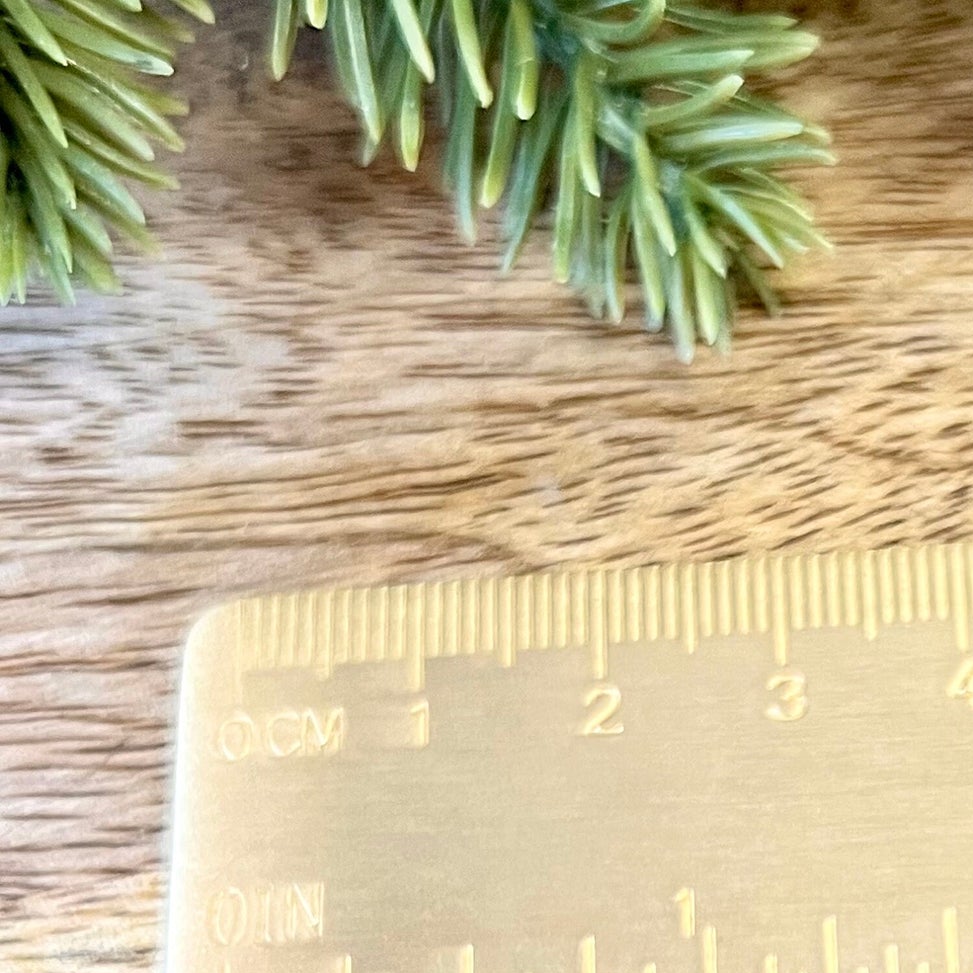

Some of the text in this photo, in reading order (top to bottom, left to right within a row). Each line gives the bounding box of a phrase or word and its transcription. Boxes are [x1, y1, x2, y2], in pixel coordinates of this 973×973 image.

[407, 698, 430, 749] 1
[581, 684, 625, 736] 2
[764, 672, 809, 722] 3
[673, 887, 696, 938] 1
